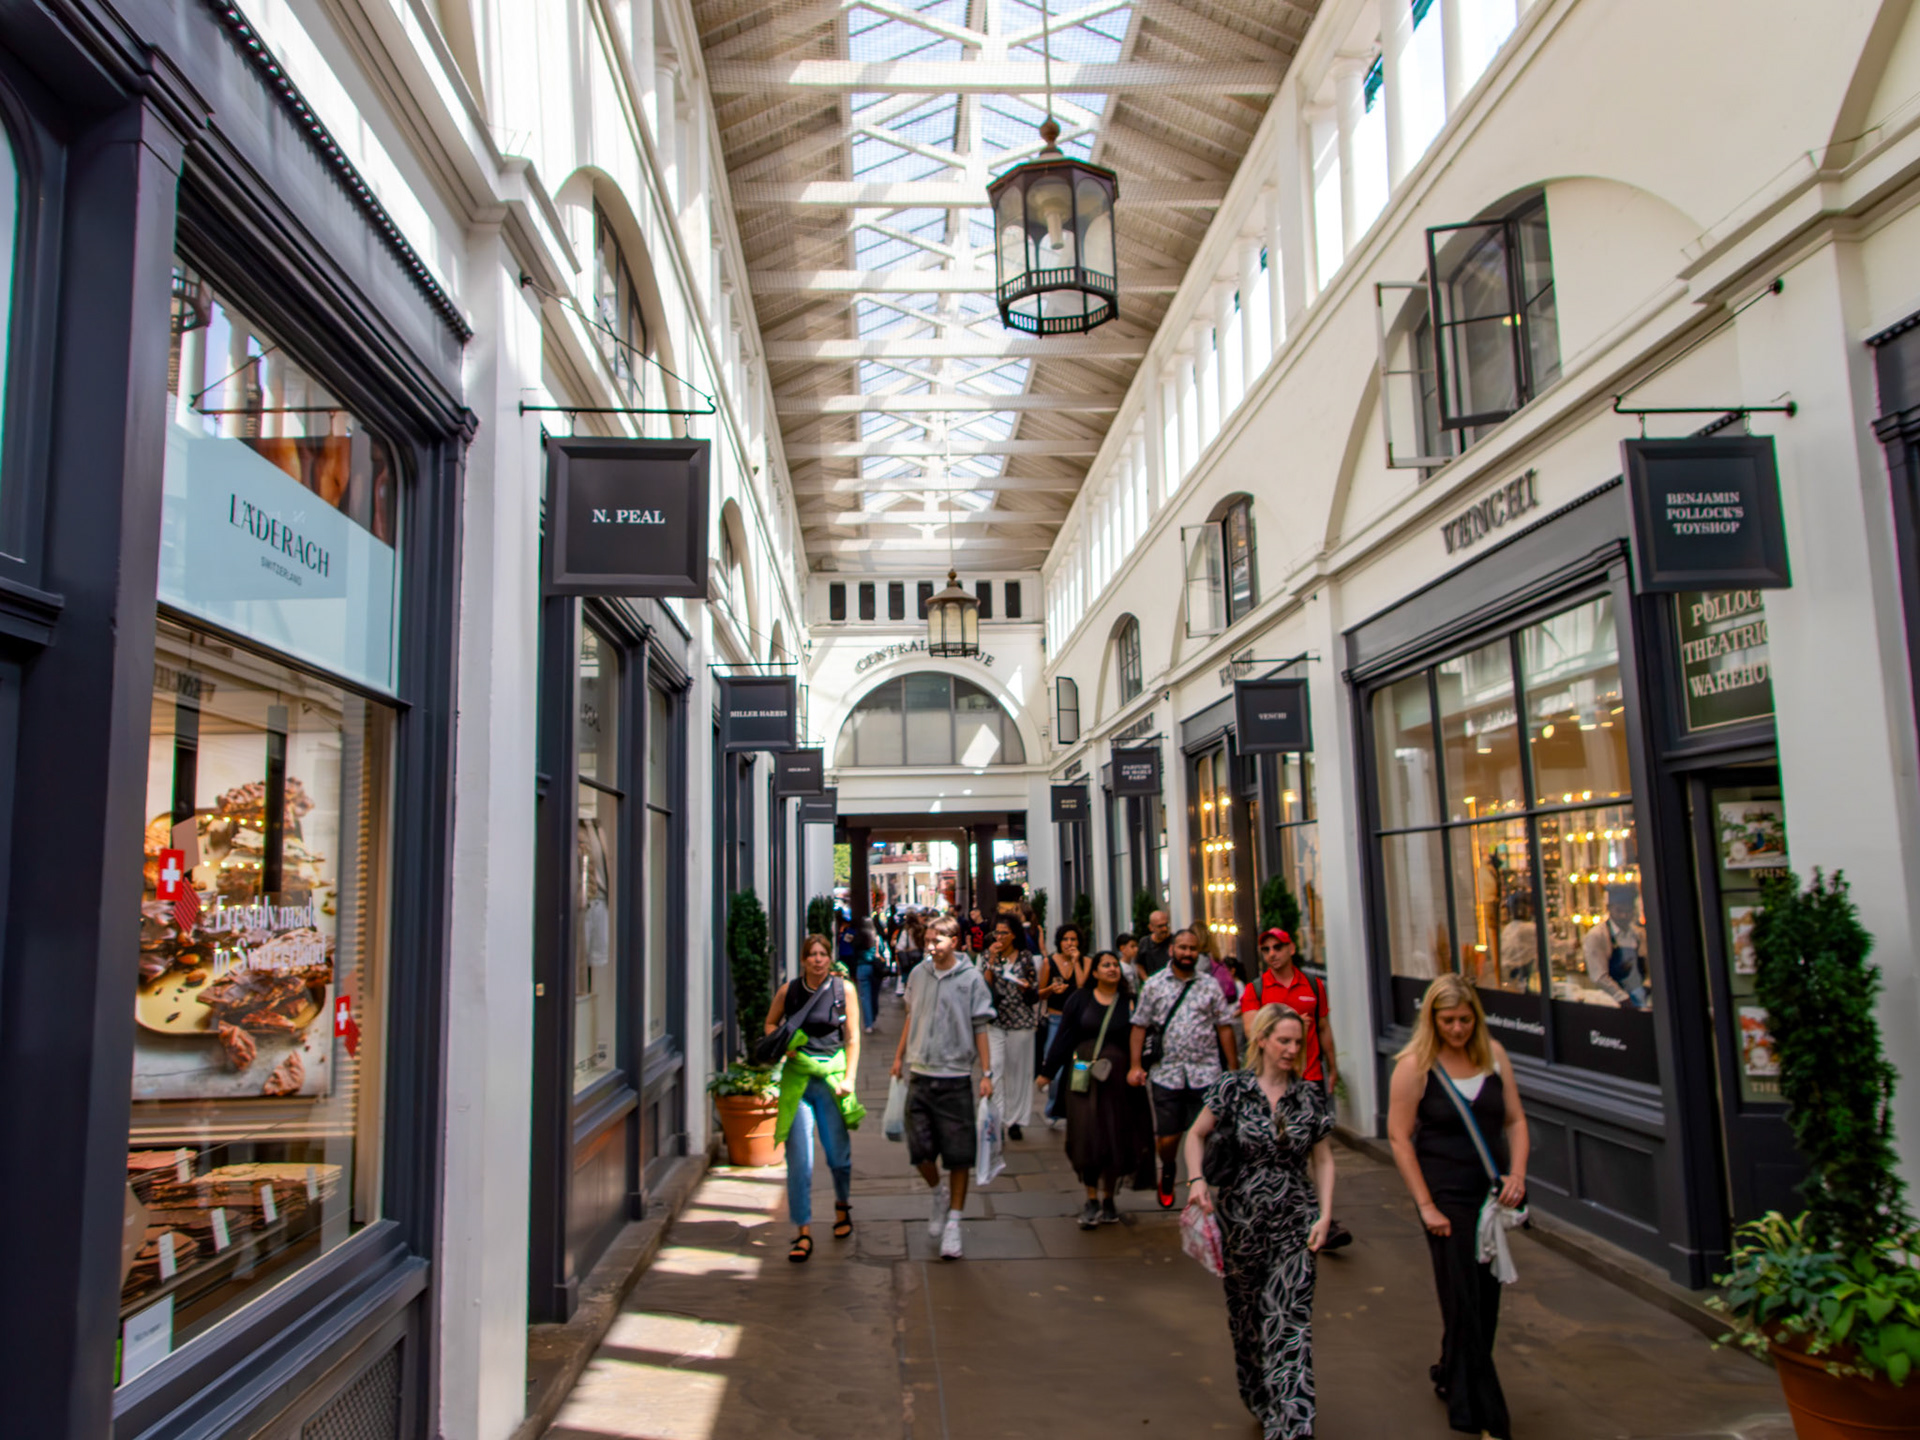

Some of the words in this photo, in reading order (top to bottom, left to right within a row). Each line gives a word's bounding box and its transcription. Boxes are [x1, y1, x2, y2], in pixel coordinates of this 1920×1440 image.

[1666, 492, 1740, 505] BENJAMIN
[592, 508, 611, 523] N.
[616, 509, 666, 524] PEAL
[1439, 467, 1540, 555] VENCHI
[1666, 506, 1744, 520] POLLOCK'S
[229, 492, 329, 578] LÄDERACH
[1672, 521, 1740, 535] TOYSHOP
[1689, 589, 1762, 627] POLLOC
[856, 640, 928, 672] CENTRAL
[1258, 712, 1287, 720] VENCHI
